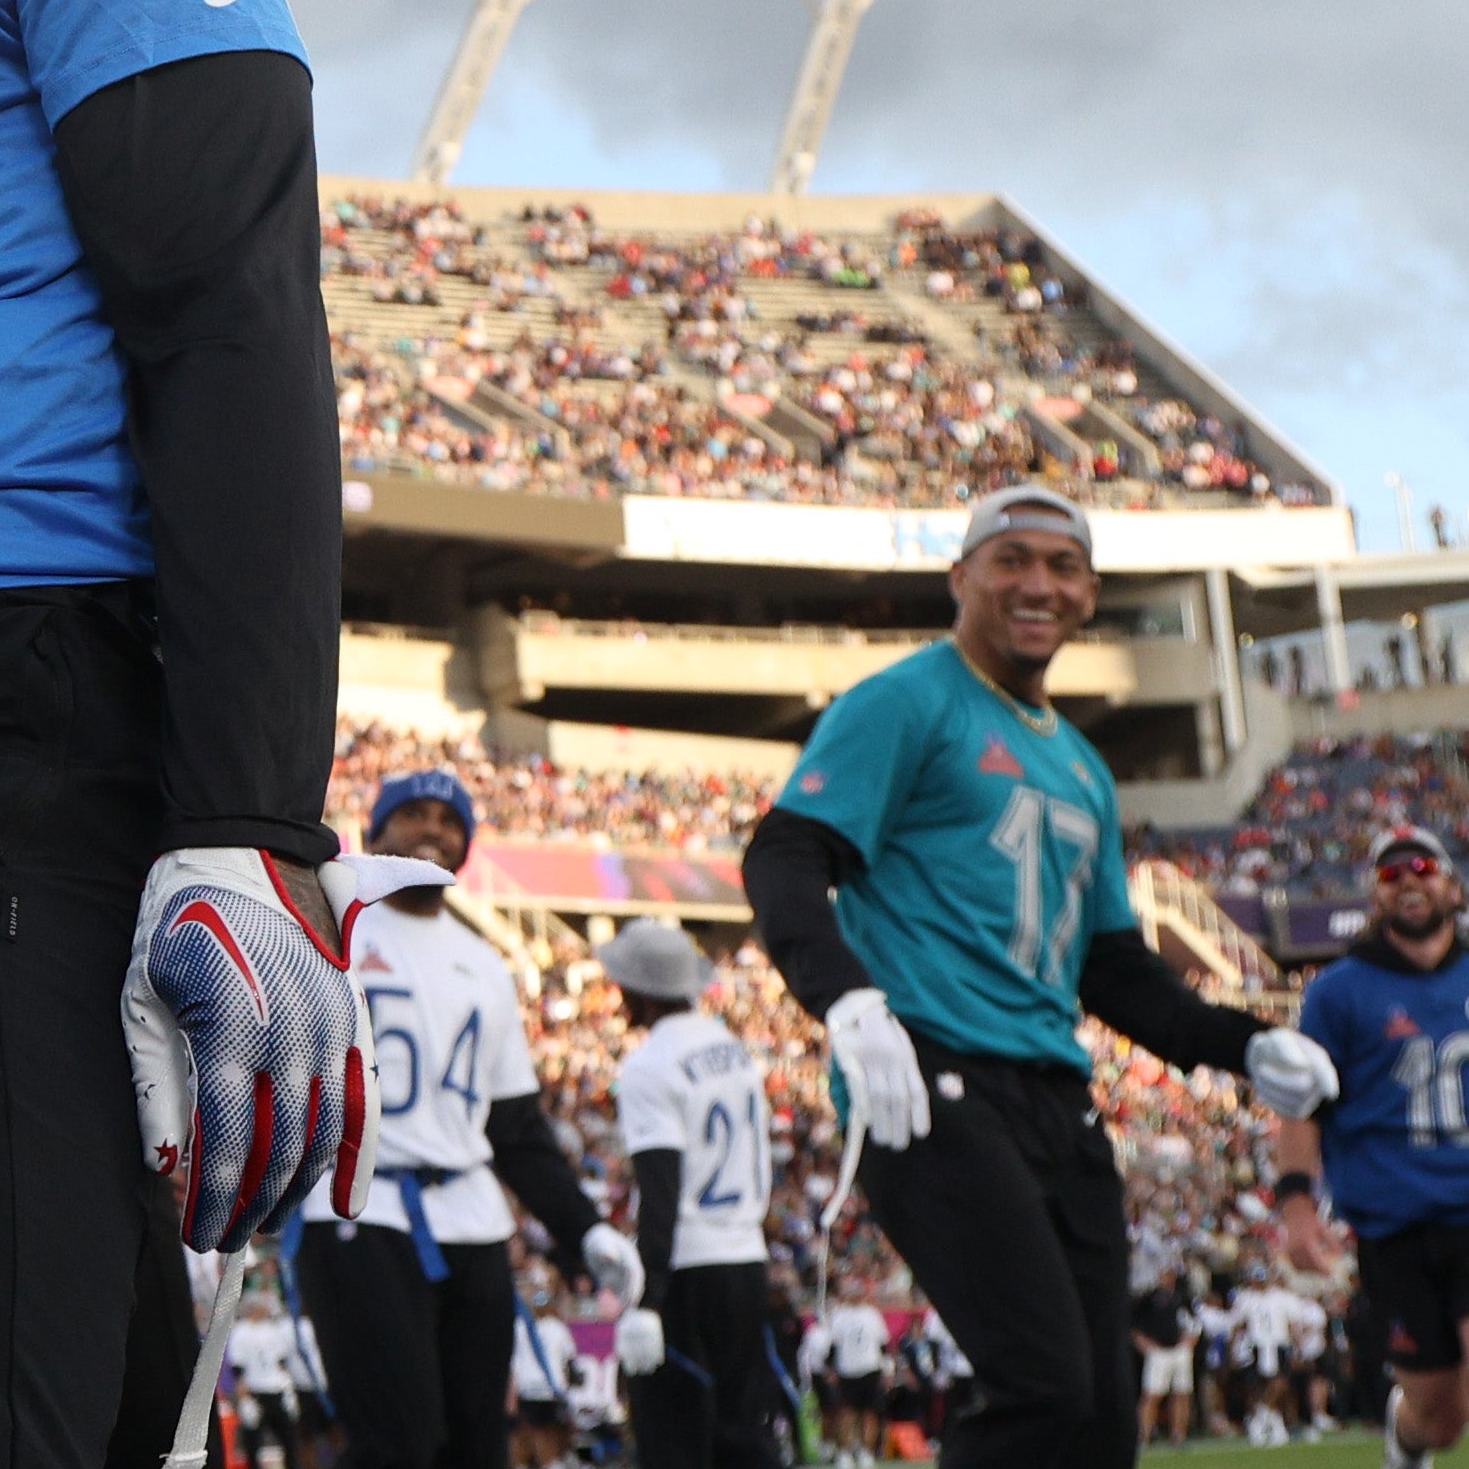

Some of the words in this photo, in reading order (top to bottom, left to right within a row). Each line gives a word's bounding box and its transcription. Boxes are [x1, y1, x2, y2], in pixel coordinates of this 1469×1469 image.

[989, 784, 1100, 988] 17
[365, 986, 482, 1122] 54
[698, 1088, 764, 1210] 21
